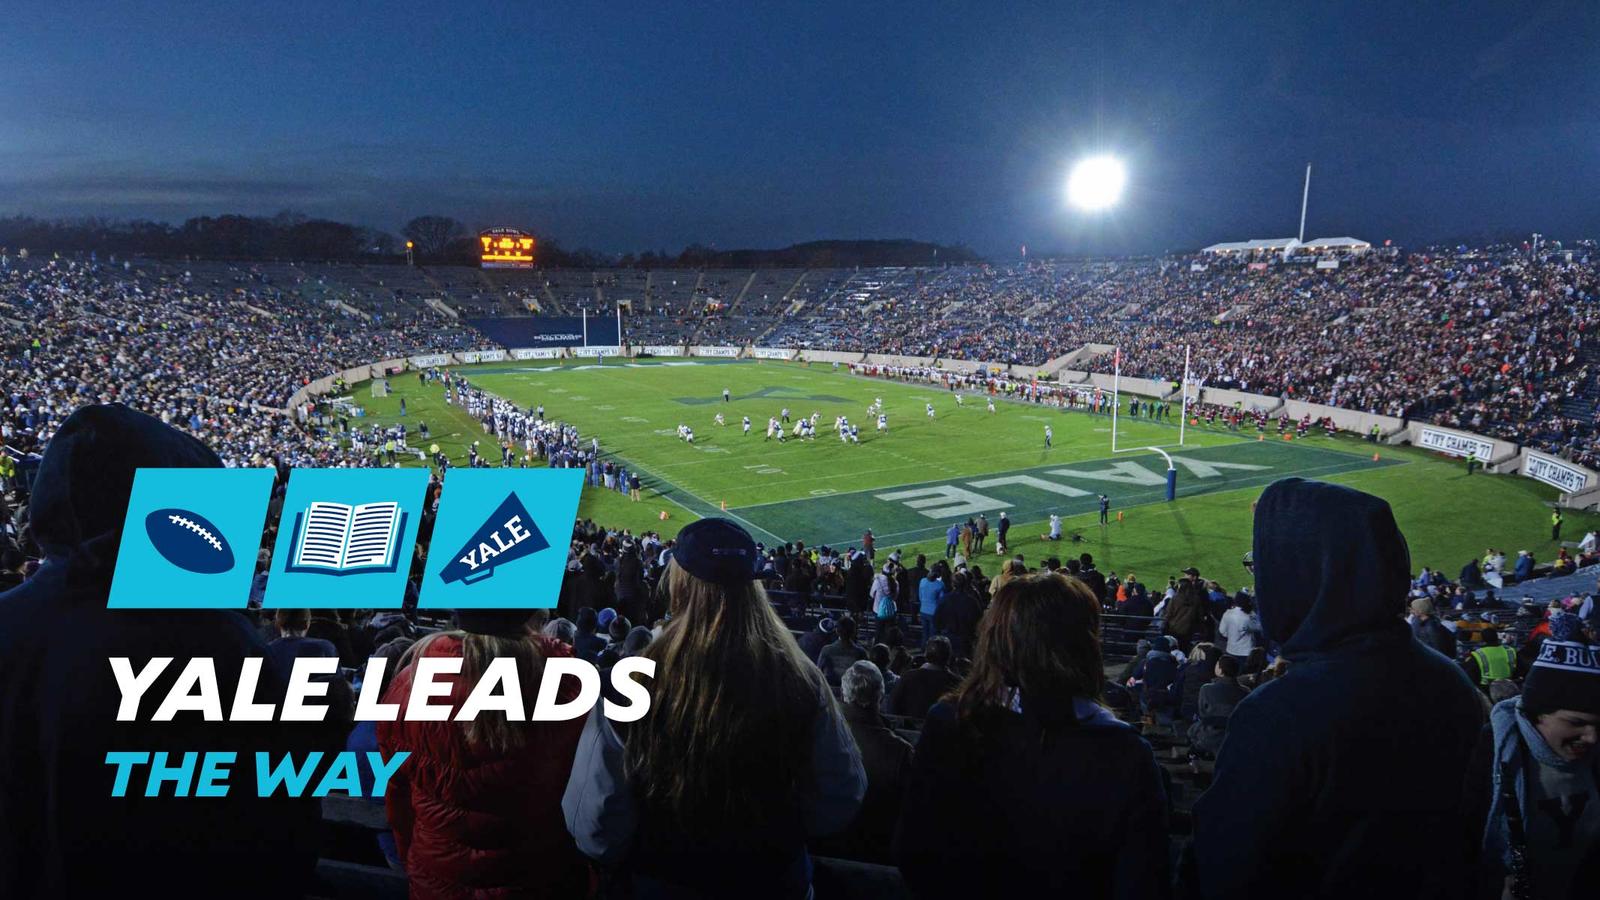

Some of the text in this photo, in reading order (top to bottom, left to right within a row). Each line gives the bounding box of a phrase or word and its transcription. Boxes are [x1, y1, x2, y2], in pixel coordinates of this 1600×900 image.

[1432, 434, 1446, 446] IVY
[1447, 436, 1477, 452] CHAMPS
[1536, 461, 1548, 476] IVY
[1548, 465, 1574, 487] CHAMPS
[874, 456, 1273, 519] YALE
